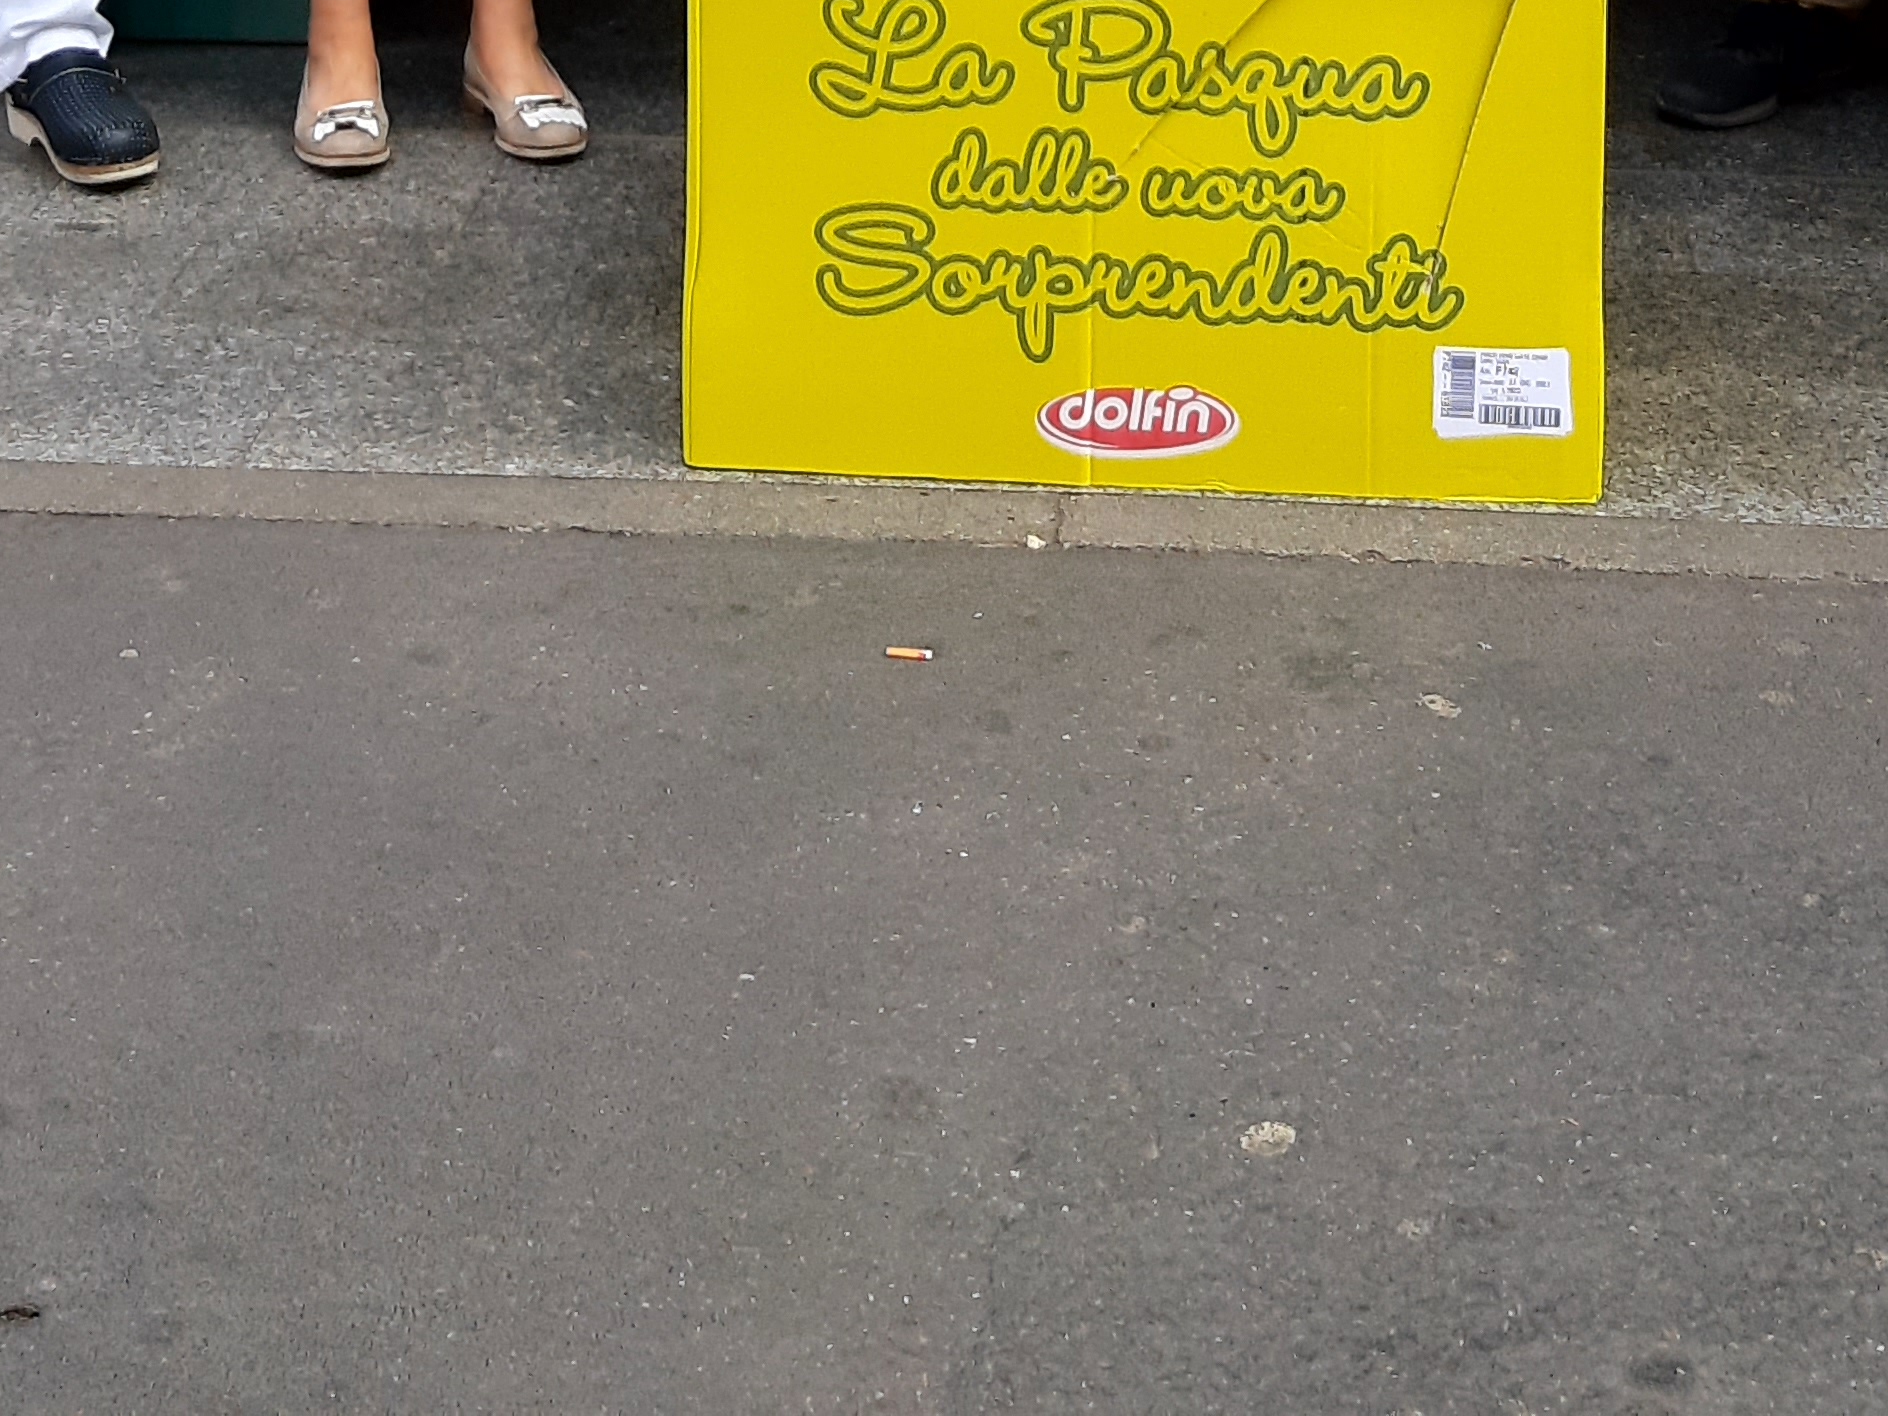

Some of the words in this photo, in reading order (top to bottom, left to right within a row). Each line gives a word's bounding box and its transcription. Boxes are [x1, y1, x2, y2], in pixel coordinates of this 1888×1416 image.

[930, 126, 1129, 215] dalle
[1139, 164, 1346, 223] uova
[814, 202, 1465, 363] Sorprendenti
[1058, 386, 1211, 435] dolfin
